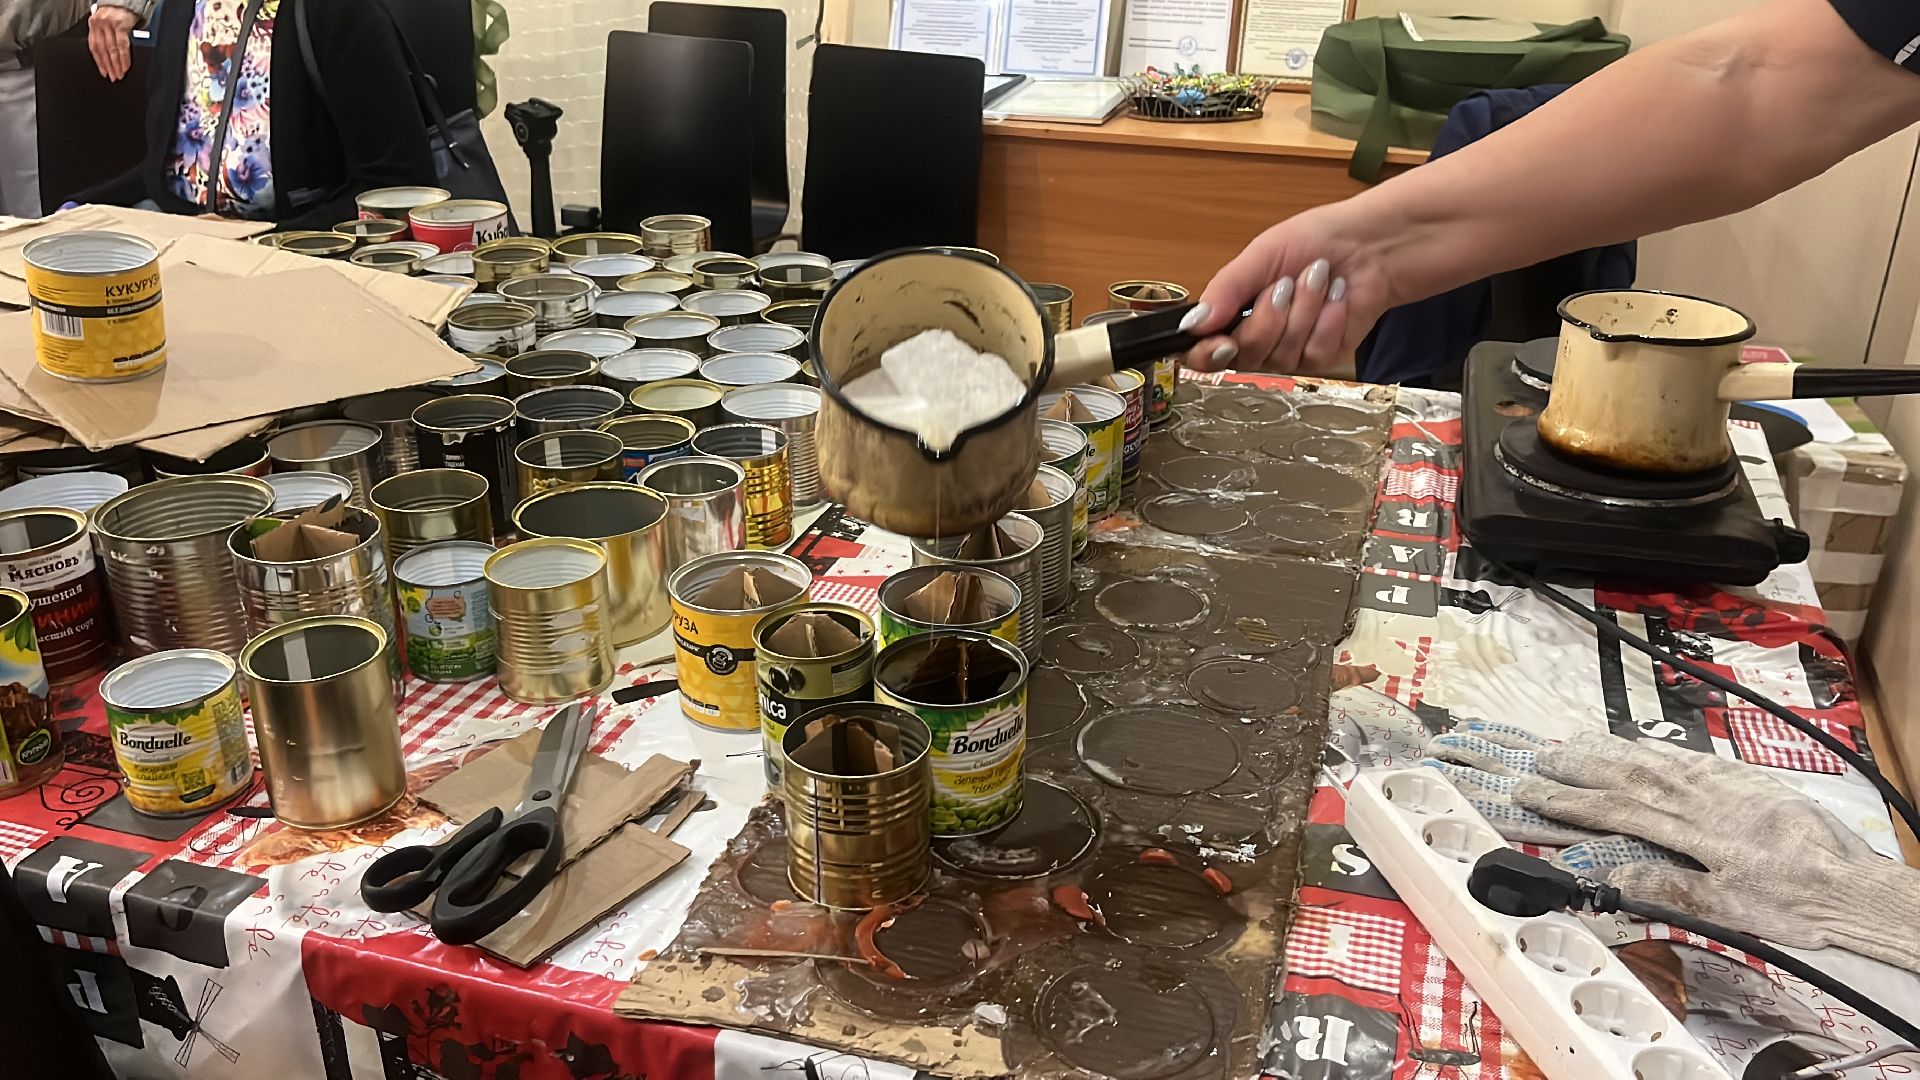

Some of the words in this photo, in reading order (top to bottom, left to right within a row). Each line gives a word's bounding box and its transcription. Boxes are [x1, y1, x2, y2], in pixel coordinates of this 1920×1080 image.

[29, 584, 83, 611] ушеная
[759, 692, 787, 719] nica
[120, 732, 192, 753] Bonduelle
